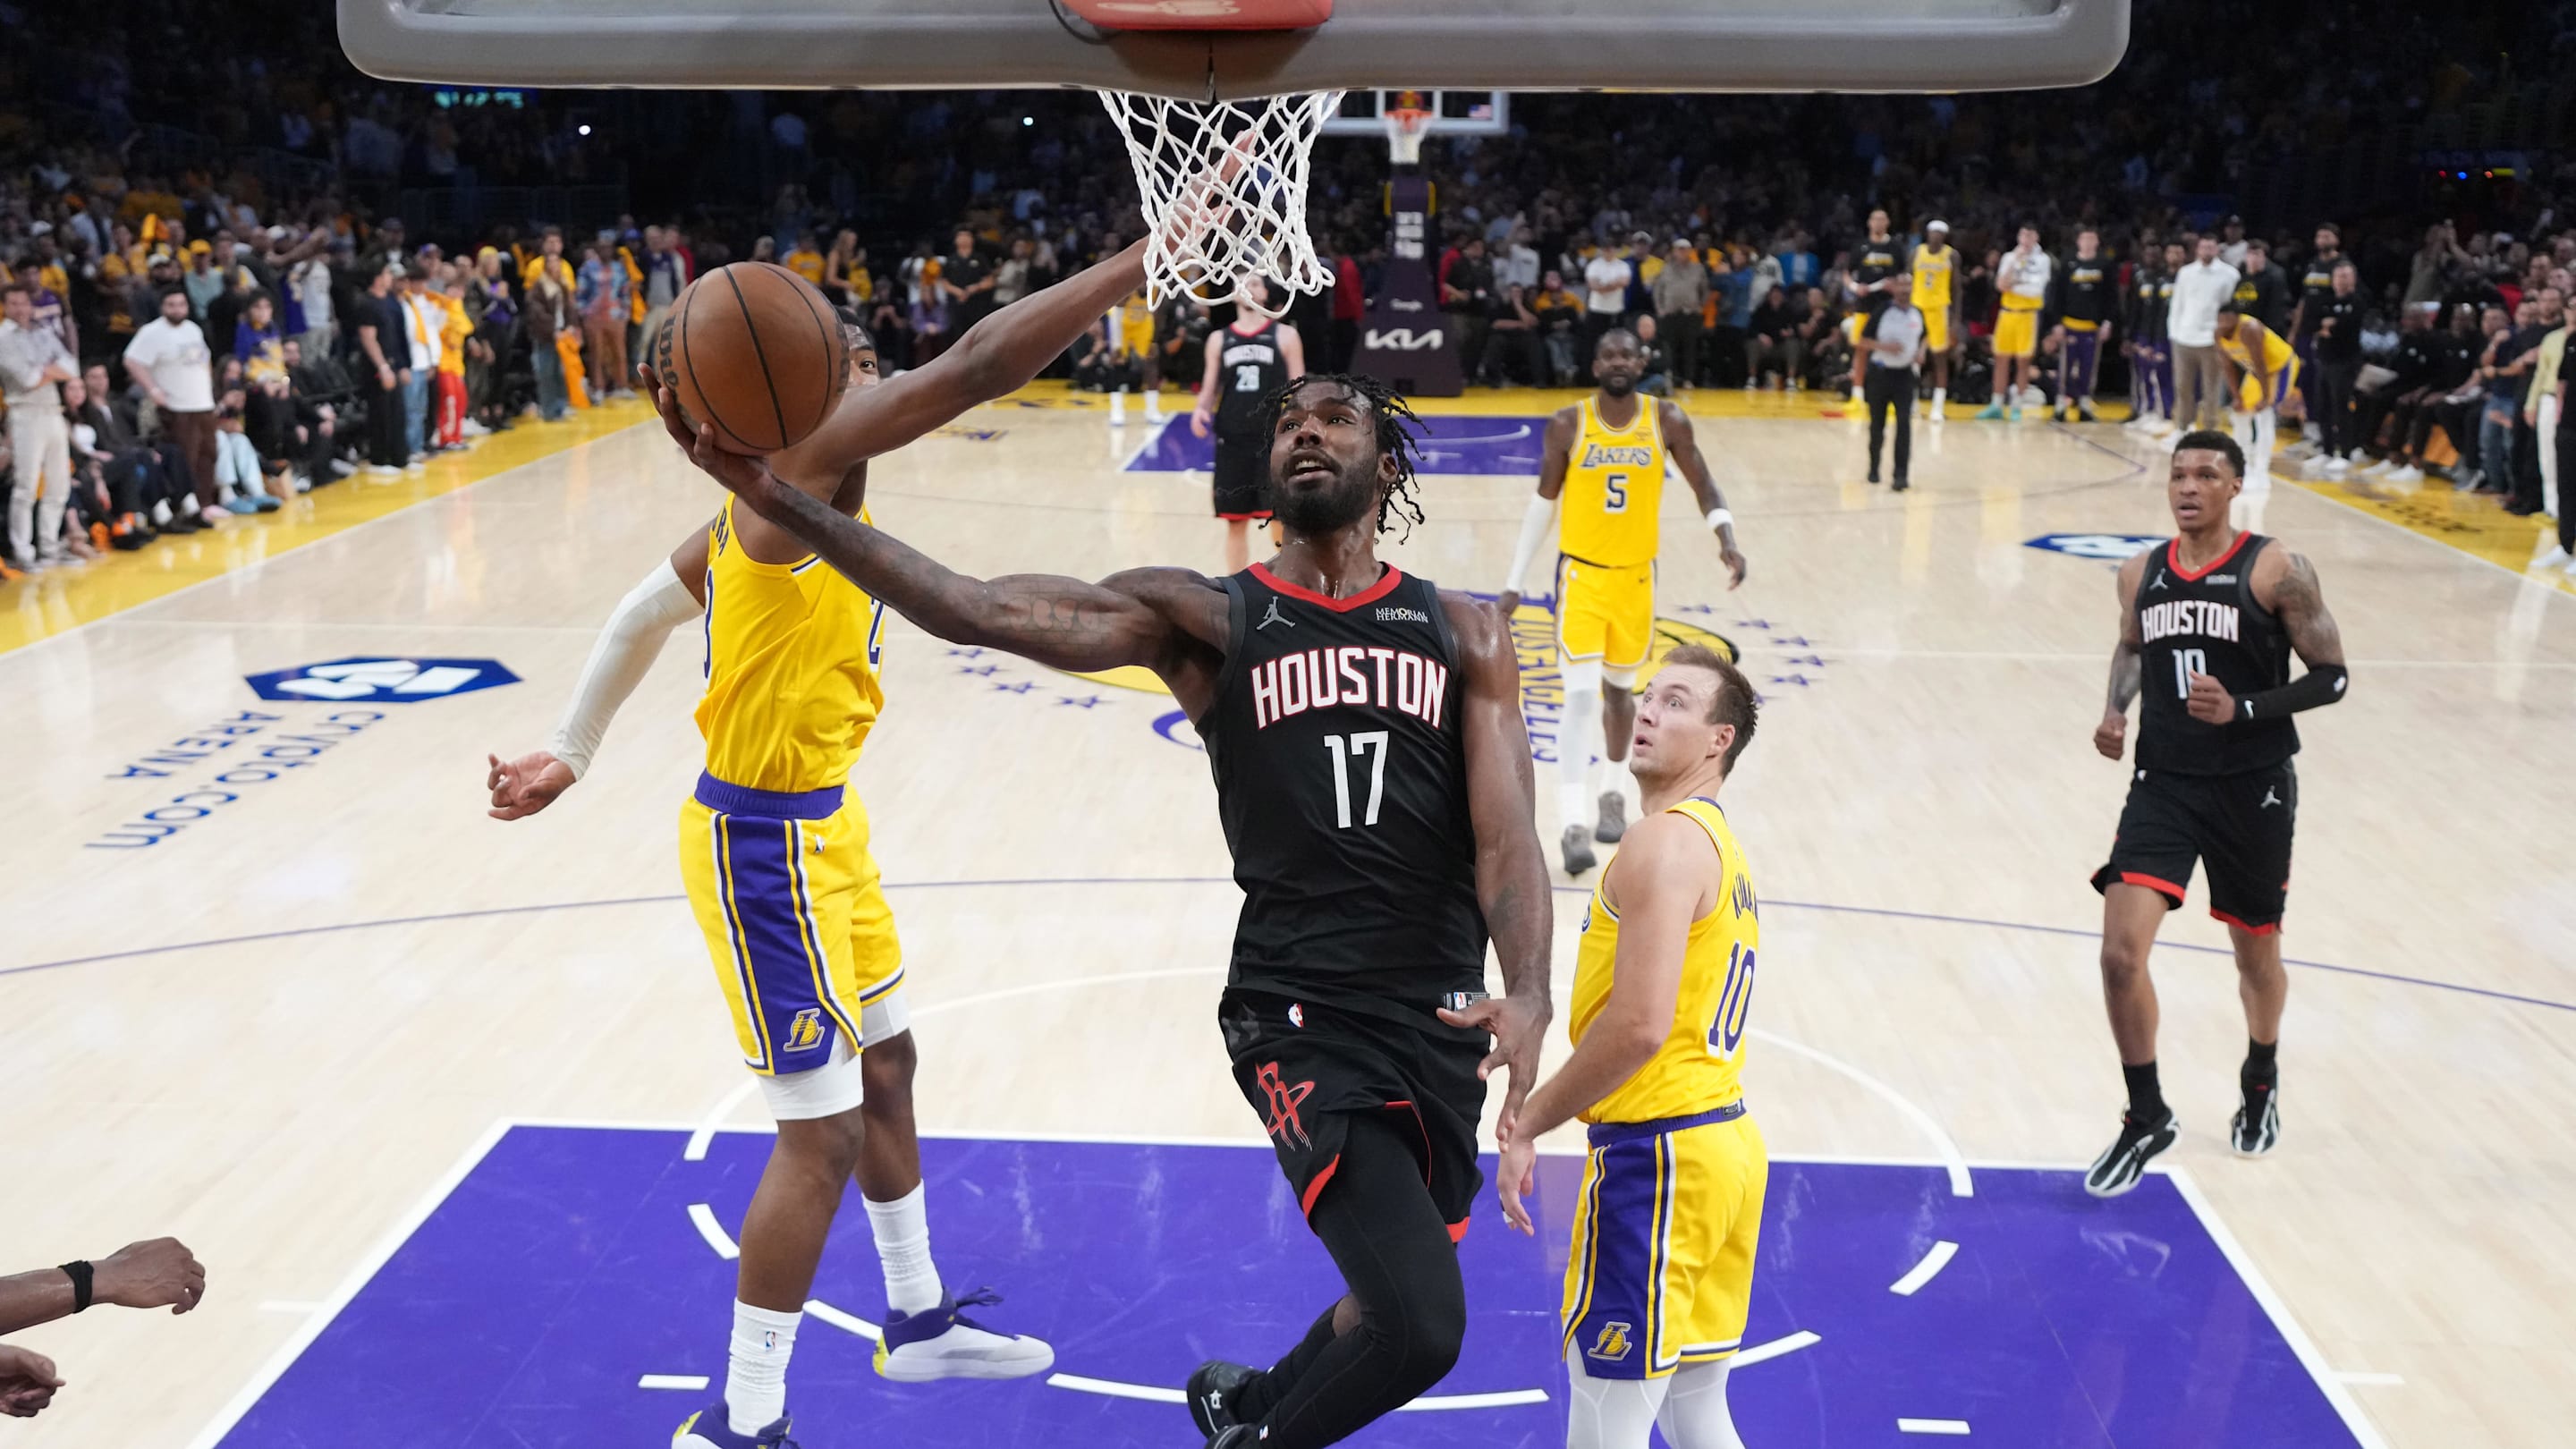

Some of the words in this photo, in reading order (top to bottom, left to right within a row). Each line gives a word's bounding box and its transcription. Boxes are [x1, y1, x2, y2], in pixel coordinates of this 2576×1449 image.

[1580, 443, 1652, 468] LAKERS
[1604, 472, 1628, 513] 5
[1376, 606, 1427, 618] MEMORIAL
[1376, 612, 1429, 623] HERMANN
[2141, 599, 2240, 644] HOUSTON
[1250, 646, 1447, 730] HOUSTON
[106, 709, 283, 781] ARENA
[84, 709, 386, 850] crypto.com
[1324, 731, 1390, 829] 17
[1707, 941, 1758, 1062] 10
